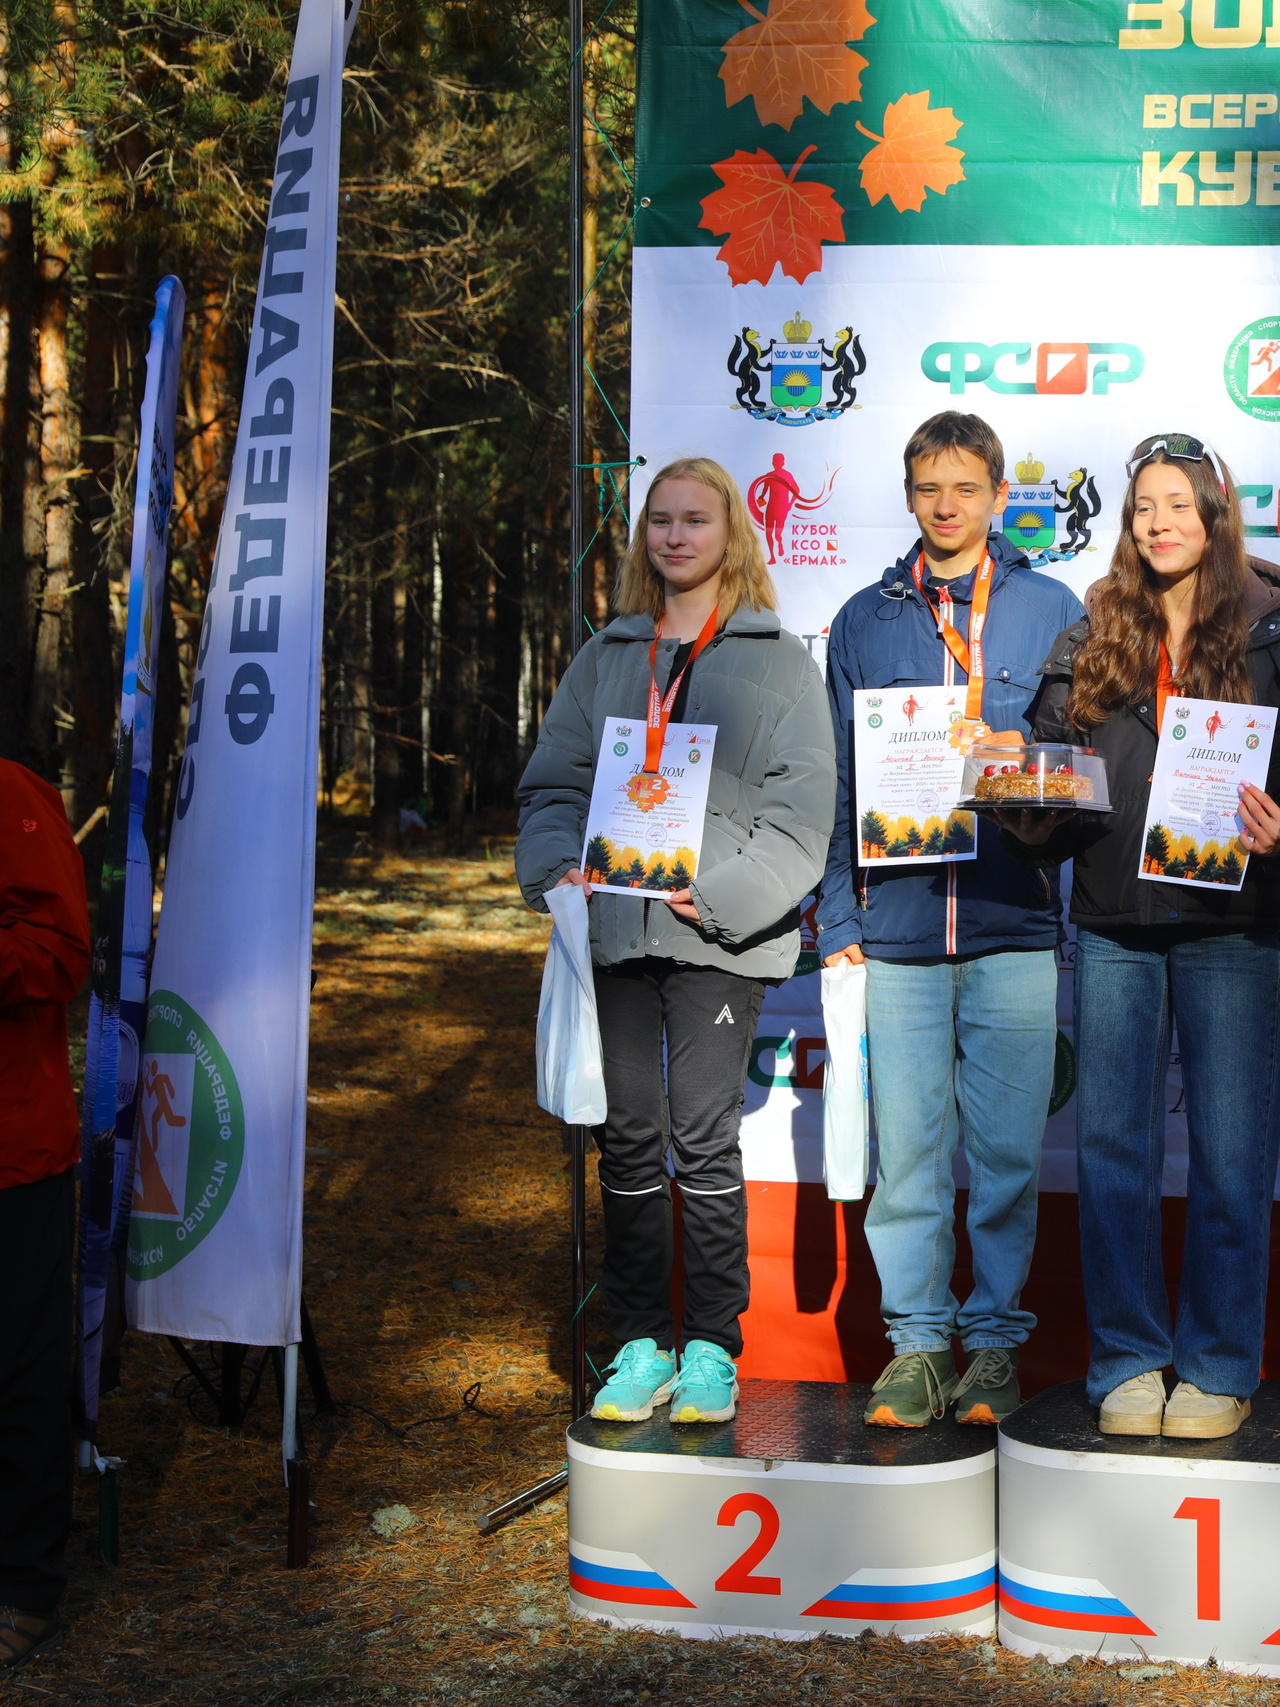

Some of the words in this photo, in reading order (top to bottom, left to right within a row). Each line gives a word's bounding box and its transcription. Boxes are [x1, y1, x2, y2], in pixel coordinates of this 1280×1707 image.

[1228, 329, 1254, 370] ФЕДЕРАЦИЯ
[1228, 373, 1249, 406] ОБЛАСТИ
[791, 524, 838, 536] КУБОК
[791, 539, 821, 551] КСО
[783, 554, 847, 566] «ЕРМАК»
[888, 730, 947, 744] ДИПЛОМ
[973, 725, 985, 737] 2
[1186, 747, 1242, 764] ДИПЛОМ
[629, 763, 685, 778] ДЛОМ
[651, 778, 663, 790] 2
[714, 1492, 782, 1596] 2
[1171, 1496, 1221, 1621] 1
